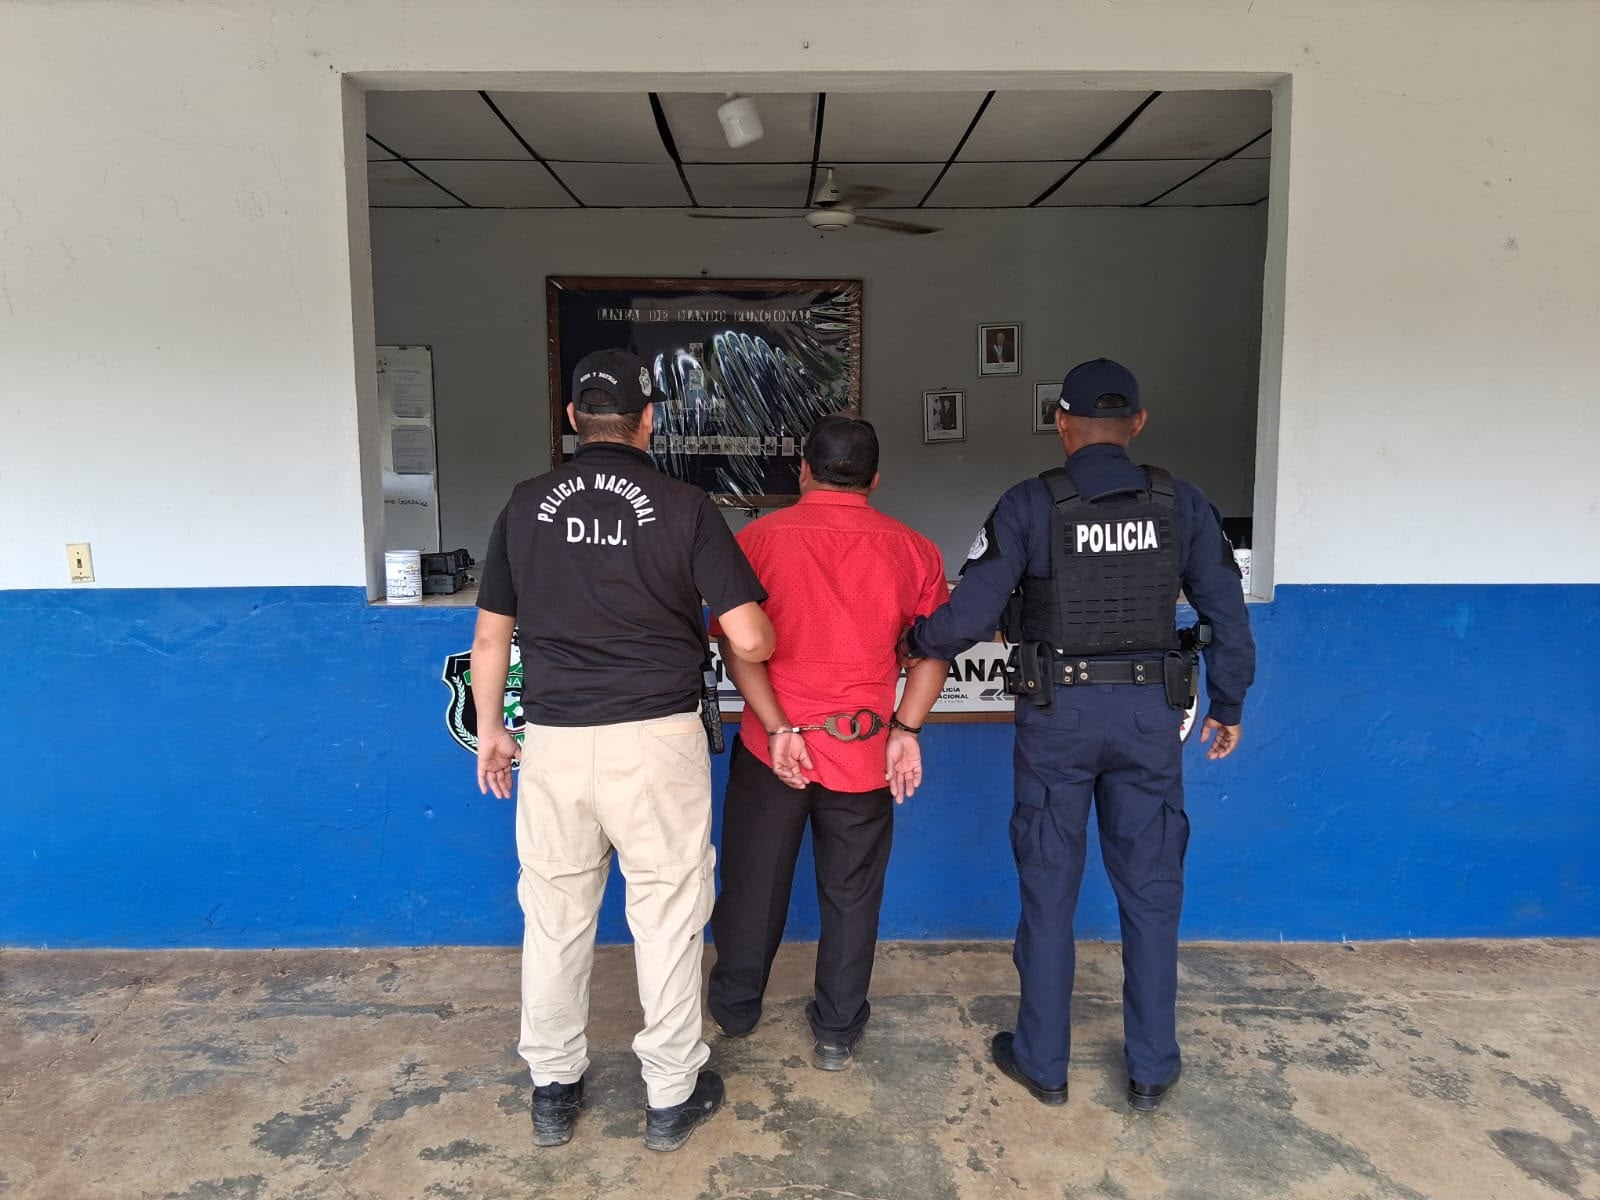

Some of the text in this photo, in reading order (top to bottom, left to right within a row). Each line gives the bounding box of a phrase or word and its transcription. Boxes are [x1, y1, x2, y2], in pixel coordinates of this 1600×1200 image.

[649, 309, 669, 322] DE
[537, 473, 656, 527] POLICIA NACIONAL
[566, 517, 628, 546] D.I.J.
[1076, 520, 1159, 553] POLICIA
